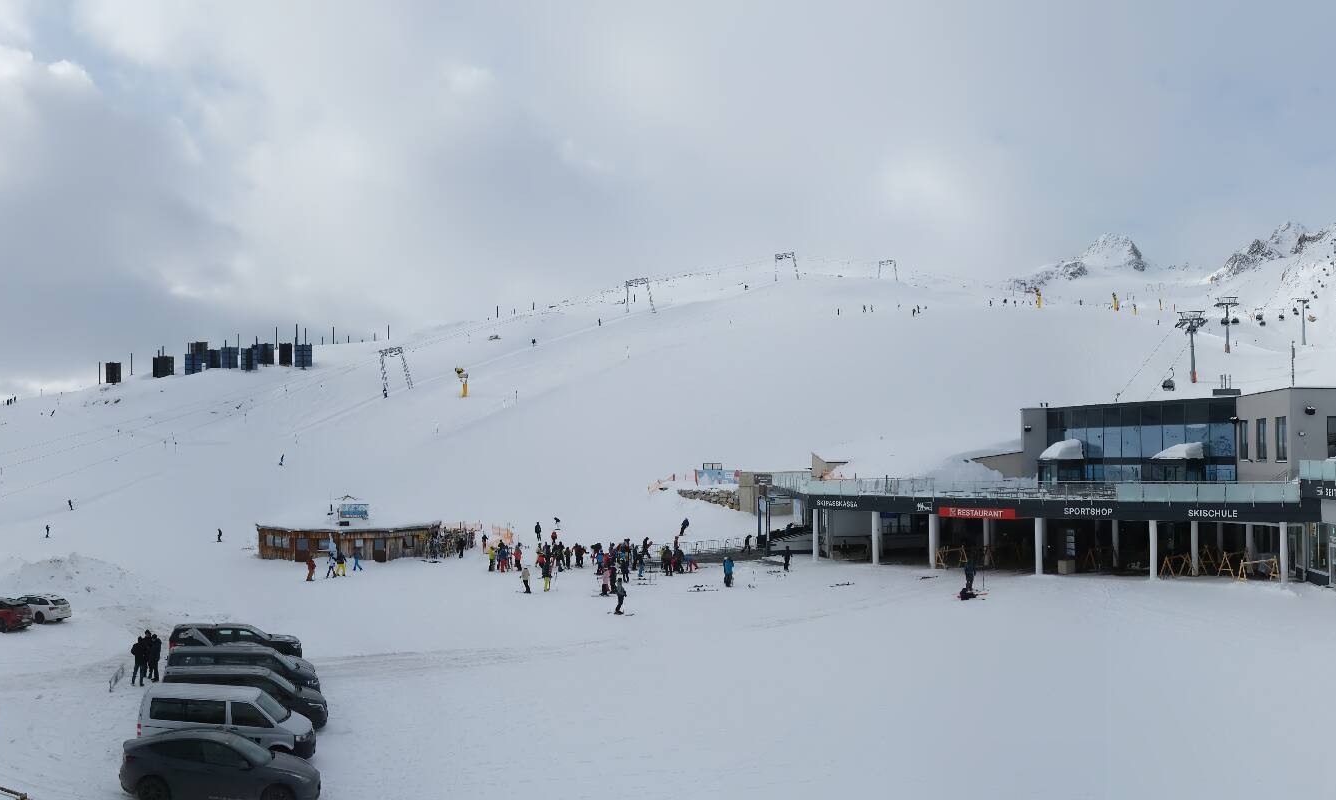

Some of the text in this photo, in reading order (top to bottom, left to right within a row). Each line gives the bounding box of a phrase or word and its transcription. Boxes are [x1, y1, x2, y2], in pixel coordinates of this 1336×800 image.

[957, 509, 1004, 519] RESTAURANT
[1063, 507, 1113, 516] SPORTSHOP
[1188, 509, 1238, 518] SKISCHULE
